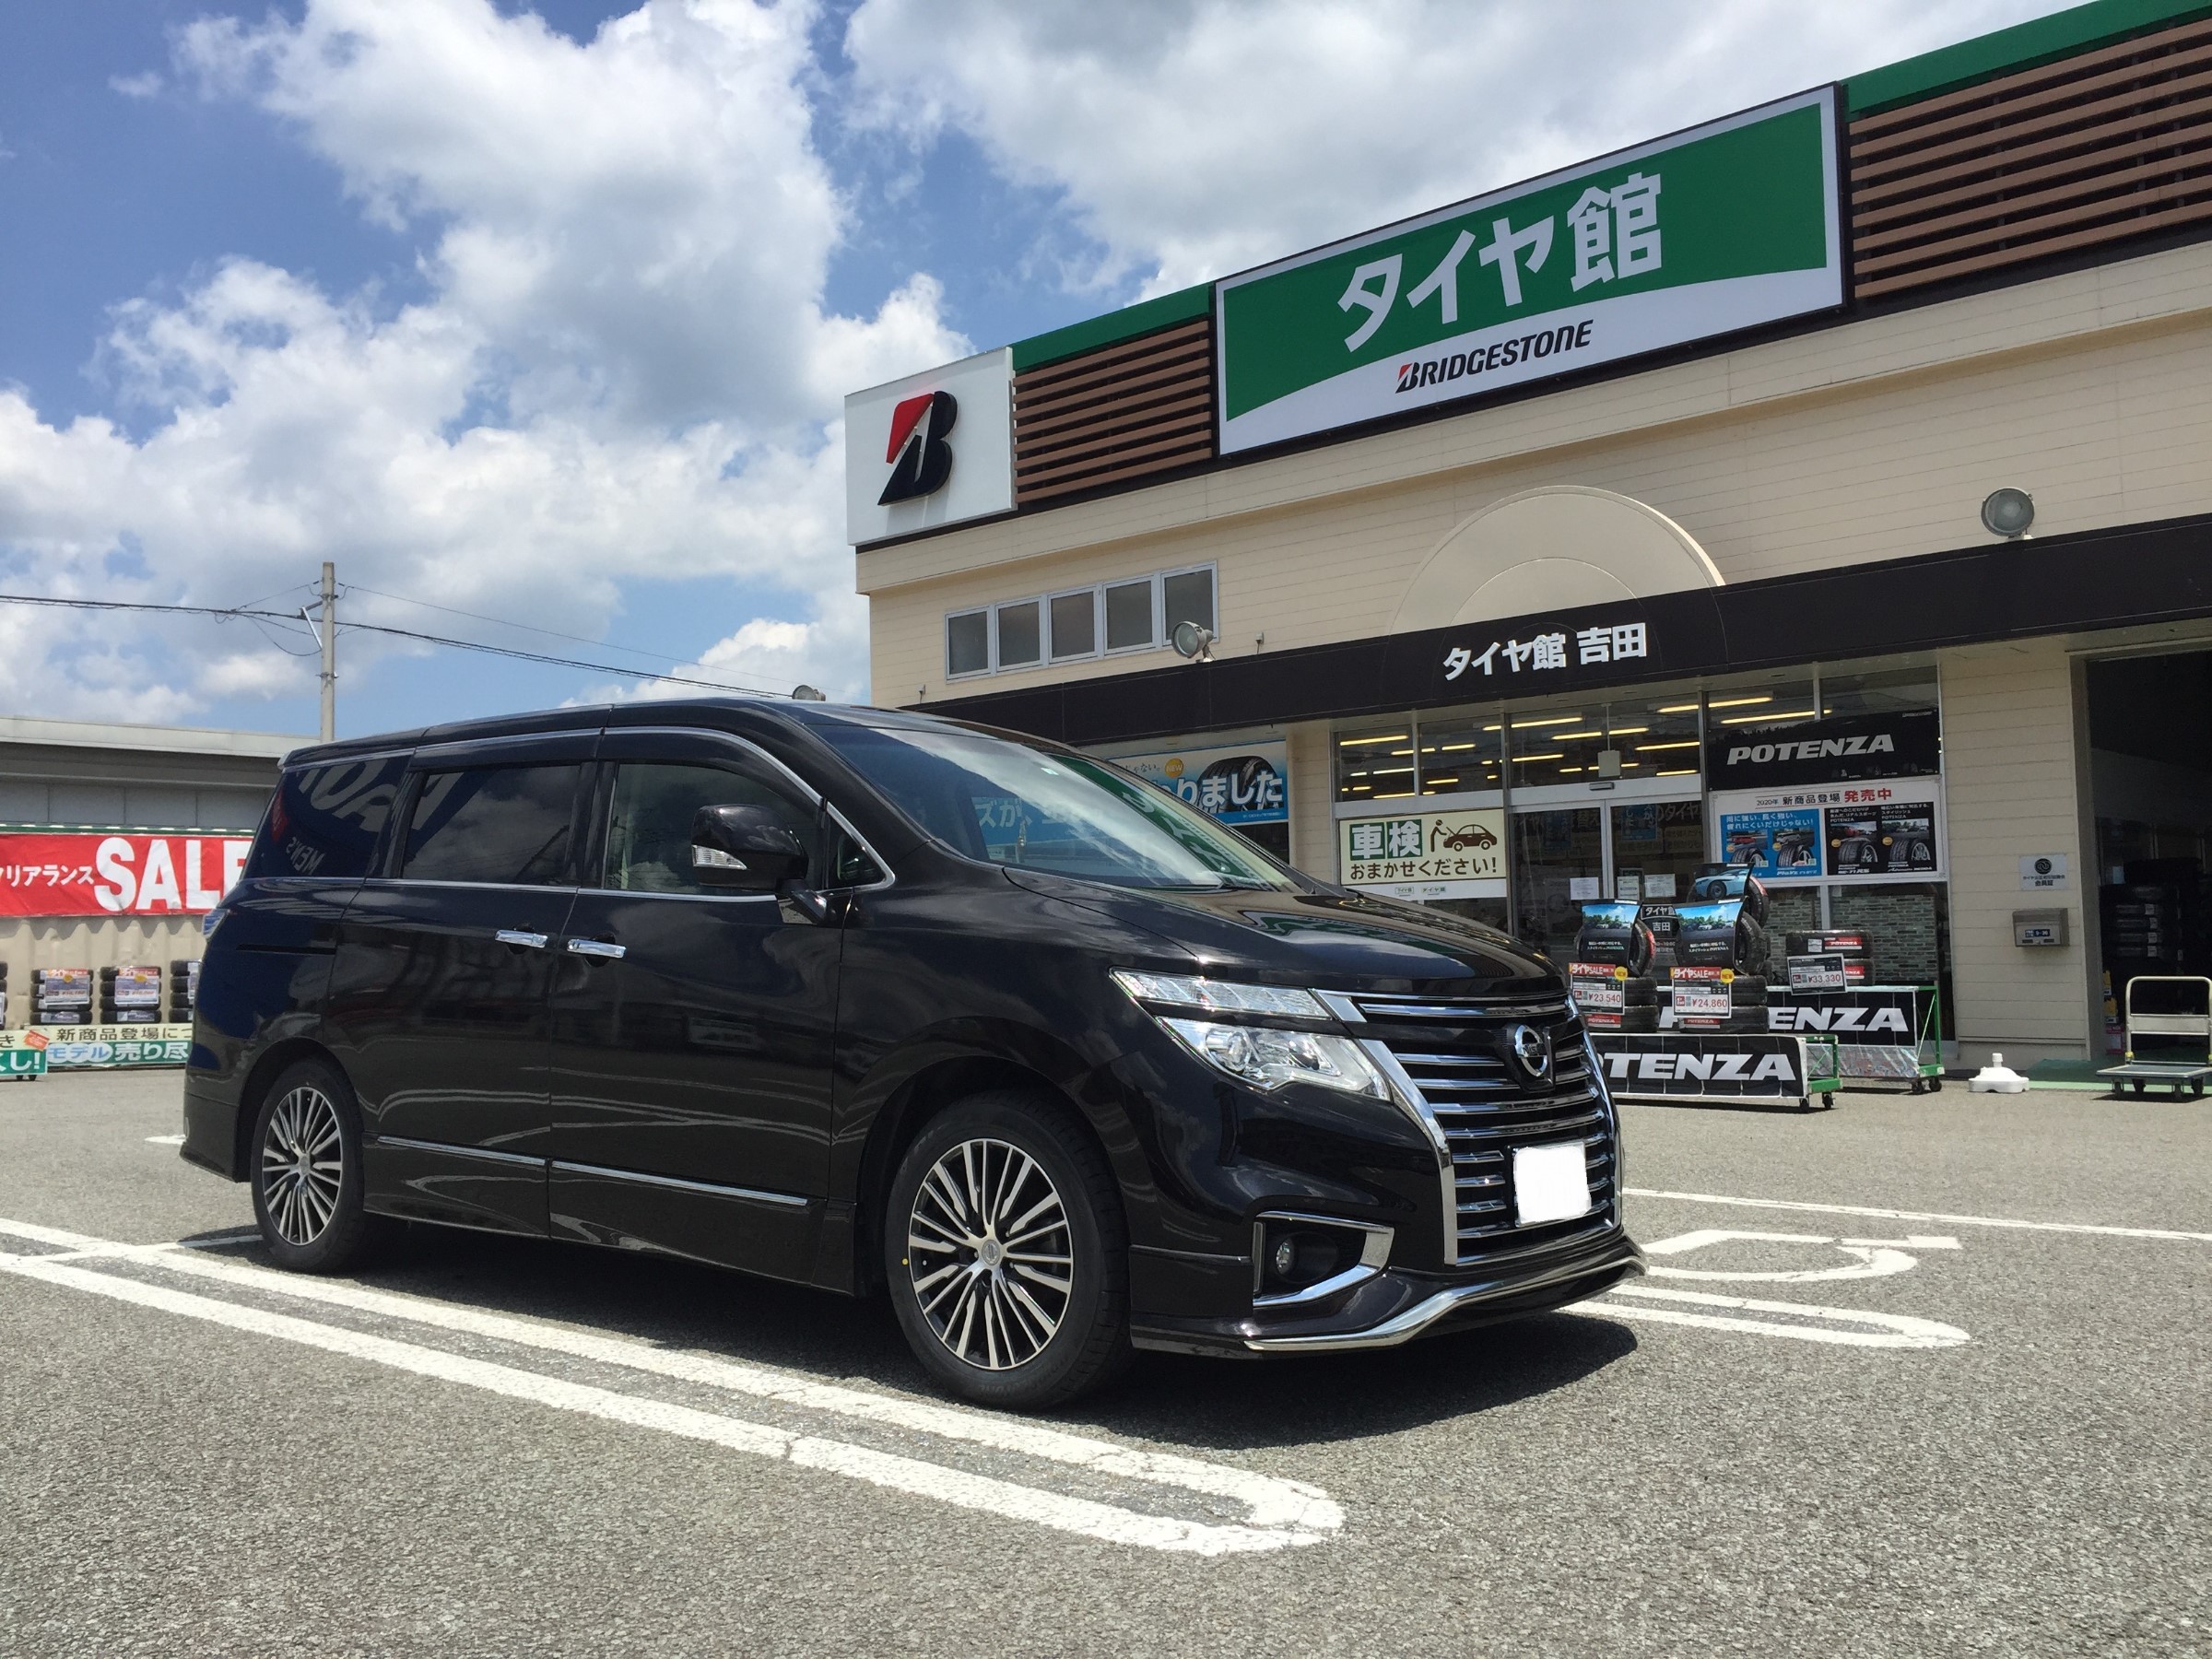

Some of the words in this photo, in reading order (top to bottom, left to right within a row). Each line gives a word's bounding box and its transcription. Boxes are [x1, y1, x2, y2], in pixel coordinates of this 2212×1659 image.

[1337, 171, 1662, 352] タイヤ館
[1395, 319, 1594, 394] BRIDGESTONE
[1442, 632, 1566, 681] タイヤ館
[1577, 622, 1647, 665] 吉田
[1727, 735, 1895, 765] POTENZA
[1167, 764, 1182, 772] NEW
[1783, 794, 1841, 806] 新商品登場
[1844, 788, 1892, 803] 発売中
[1352, 821, 1421, 859] 車検
[1350, 857, 1497, 879] おまかせください!
[1652, 922, 1671, 932] 吉田
[1599, 1053, 1796, 1081] TENZA
